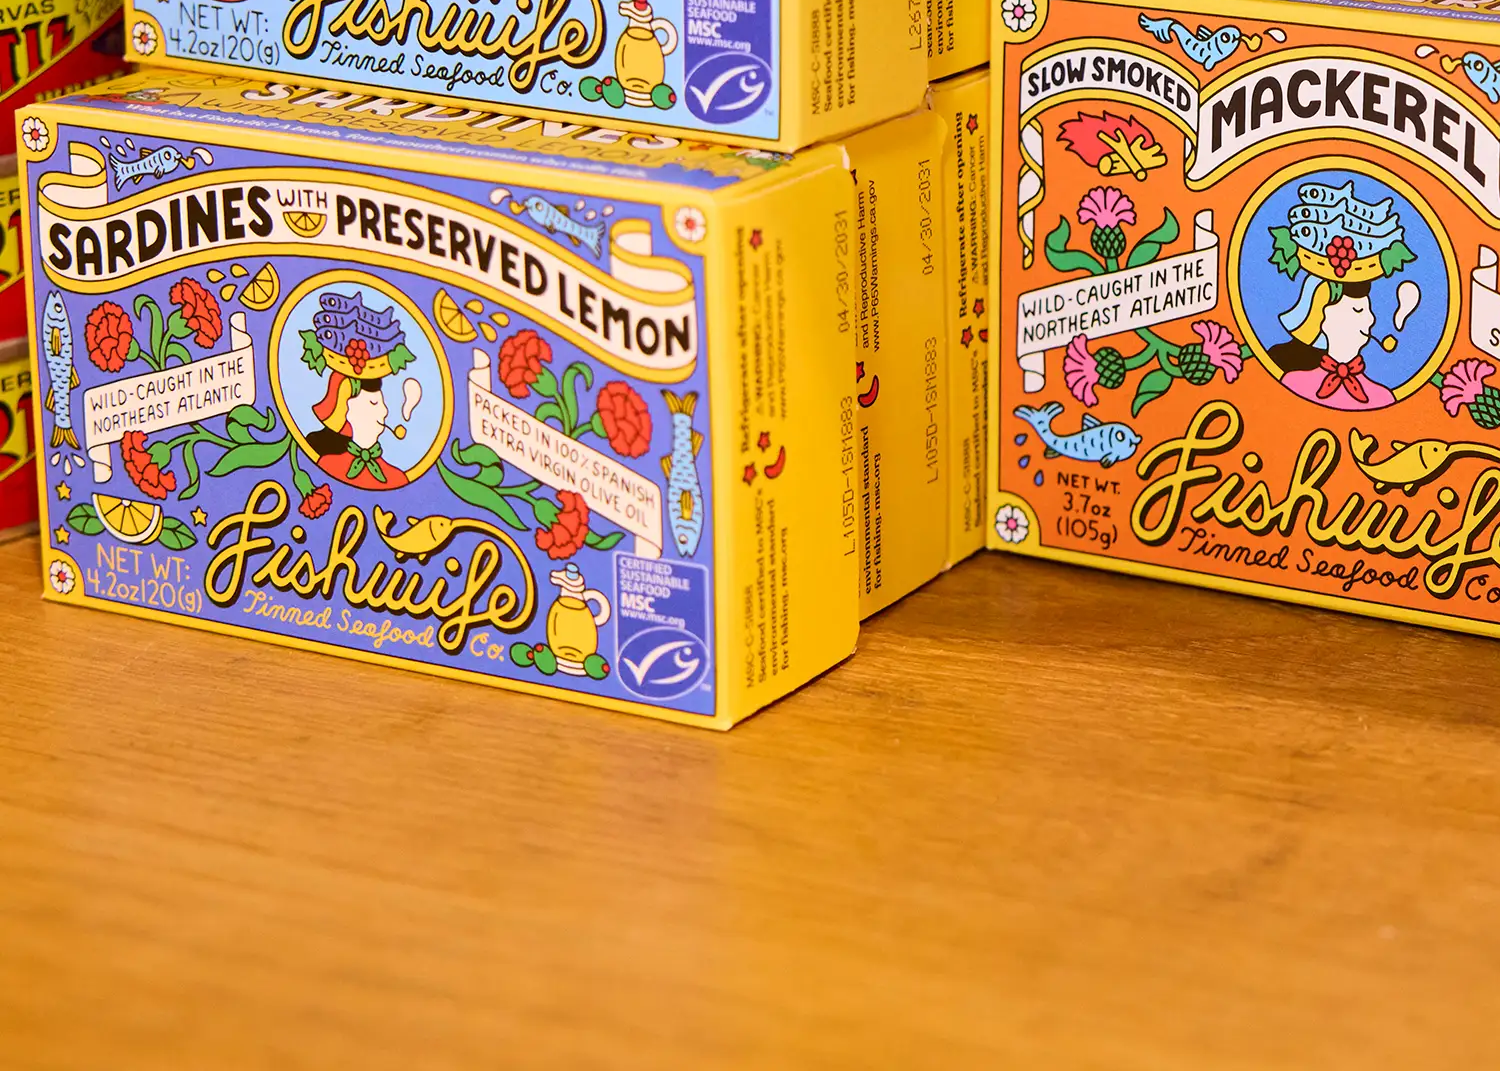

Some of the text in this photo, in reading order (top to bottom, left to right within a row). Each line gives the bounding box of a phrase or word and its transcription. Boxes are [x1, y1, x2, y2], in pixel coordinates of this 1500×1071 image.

[179, 2, 270, 32] NET WT:
[687, 7, 737, 22] SEAFOOD
[688, 20, 721, 38] MSC
[320, 39, 573, 97] Tinned Seafood Co.
[688, 36, 751, 53] www.msc.org
[1028, 57, 1192, 111] SLOW SMOKED
[1211, 70, 1486, 186] MACKEREL
[919, 160, 934, 275] 04/30/2031
[49, 187, 692, 359] SARDINES WITH PRESERVED LEMON
[834, 210, 850, 333] 04/30/2031
[868, 179, 881, 353] www.P65Warnings.ca.gov
[1022, 259, 1205, 317] WILD-CAUGHT IN THE
[1022, 282, 1213, 343] NORTHEAST ATLANTIC
[91, 356, 244, 411] WILD-CAUGHT IN THE
[94, 383, 242, 435] NORTHEAST ATLANTIC
[475, 394, 654, 507] PACKED IN 100% SPANISH
[482, 420, 647, 526] EXTRA VIRGIN OLIVE OIL
[1057, 470, 1090, 489] NET
[1063, 492, 1111, 519] 3.7oz
[860, 425, 873, 595] environmental standard
[870, 452, 883, 589] for fishing. msc.org
[1055, 515, 1117, 548] (105g)
[98, 545, 191, 581] NET WT:
[206, 479, 537, 655] Fishwife
[621, 560, 672, 575] CERTIFIED
[621, 570, 690, 590] SUSTAINABLE
[1180, 526, 1288, 569] Tinned
[1296, 541, 1418, 589] Seafood
[621, 582, 670, 598] SEAFOOD
[622, 594, 655, 612] MSC
[244, 590, 505, 662] Tinned Seafood Co.
[621, 610, 686, 628] www.msc.org
